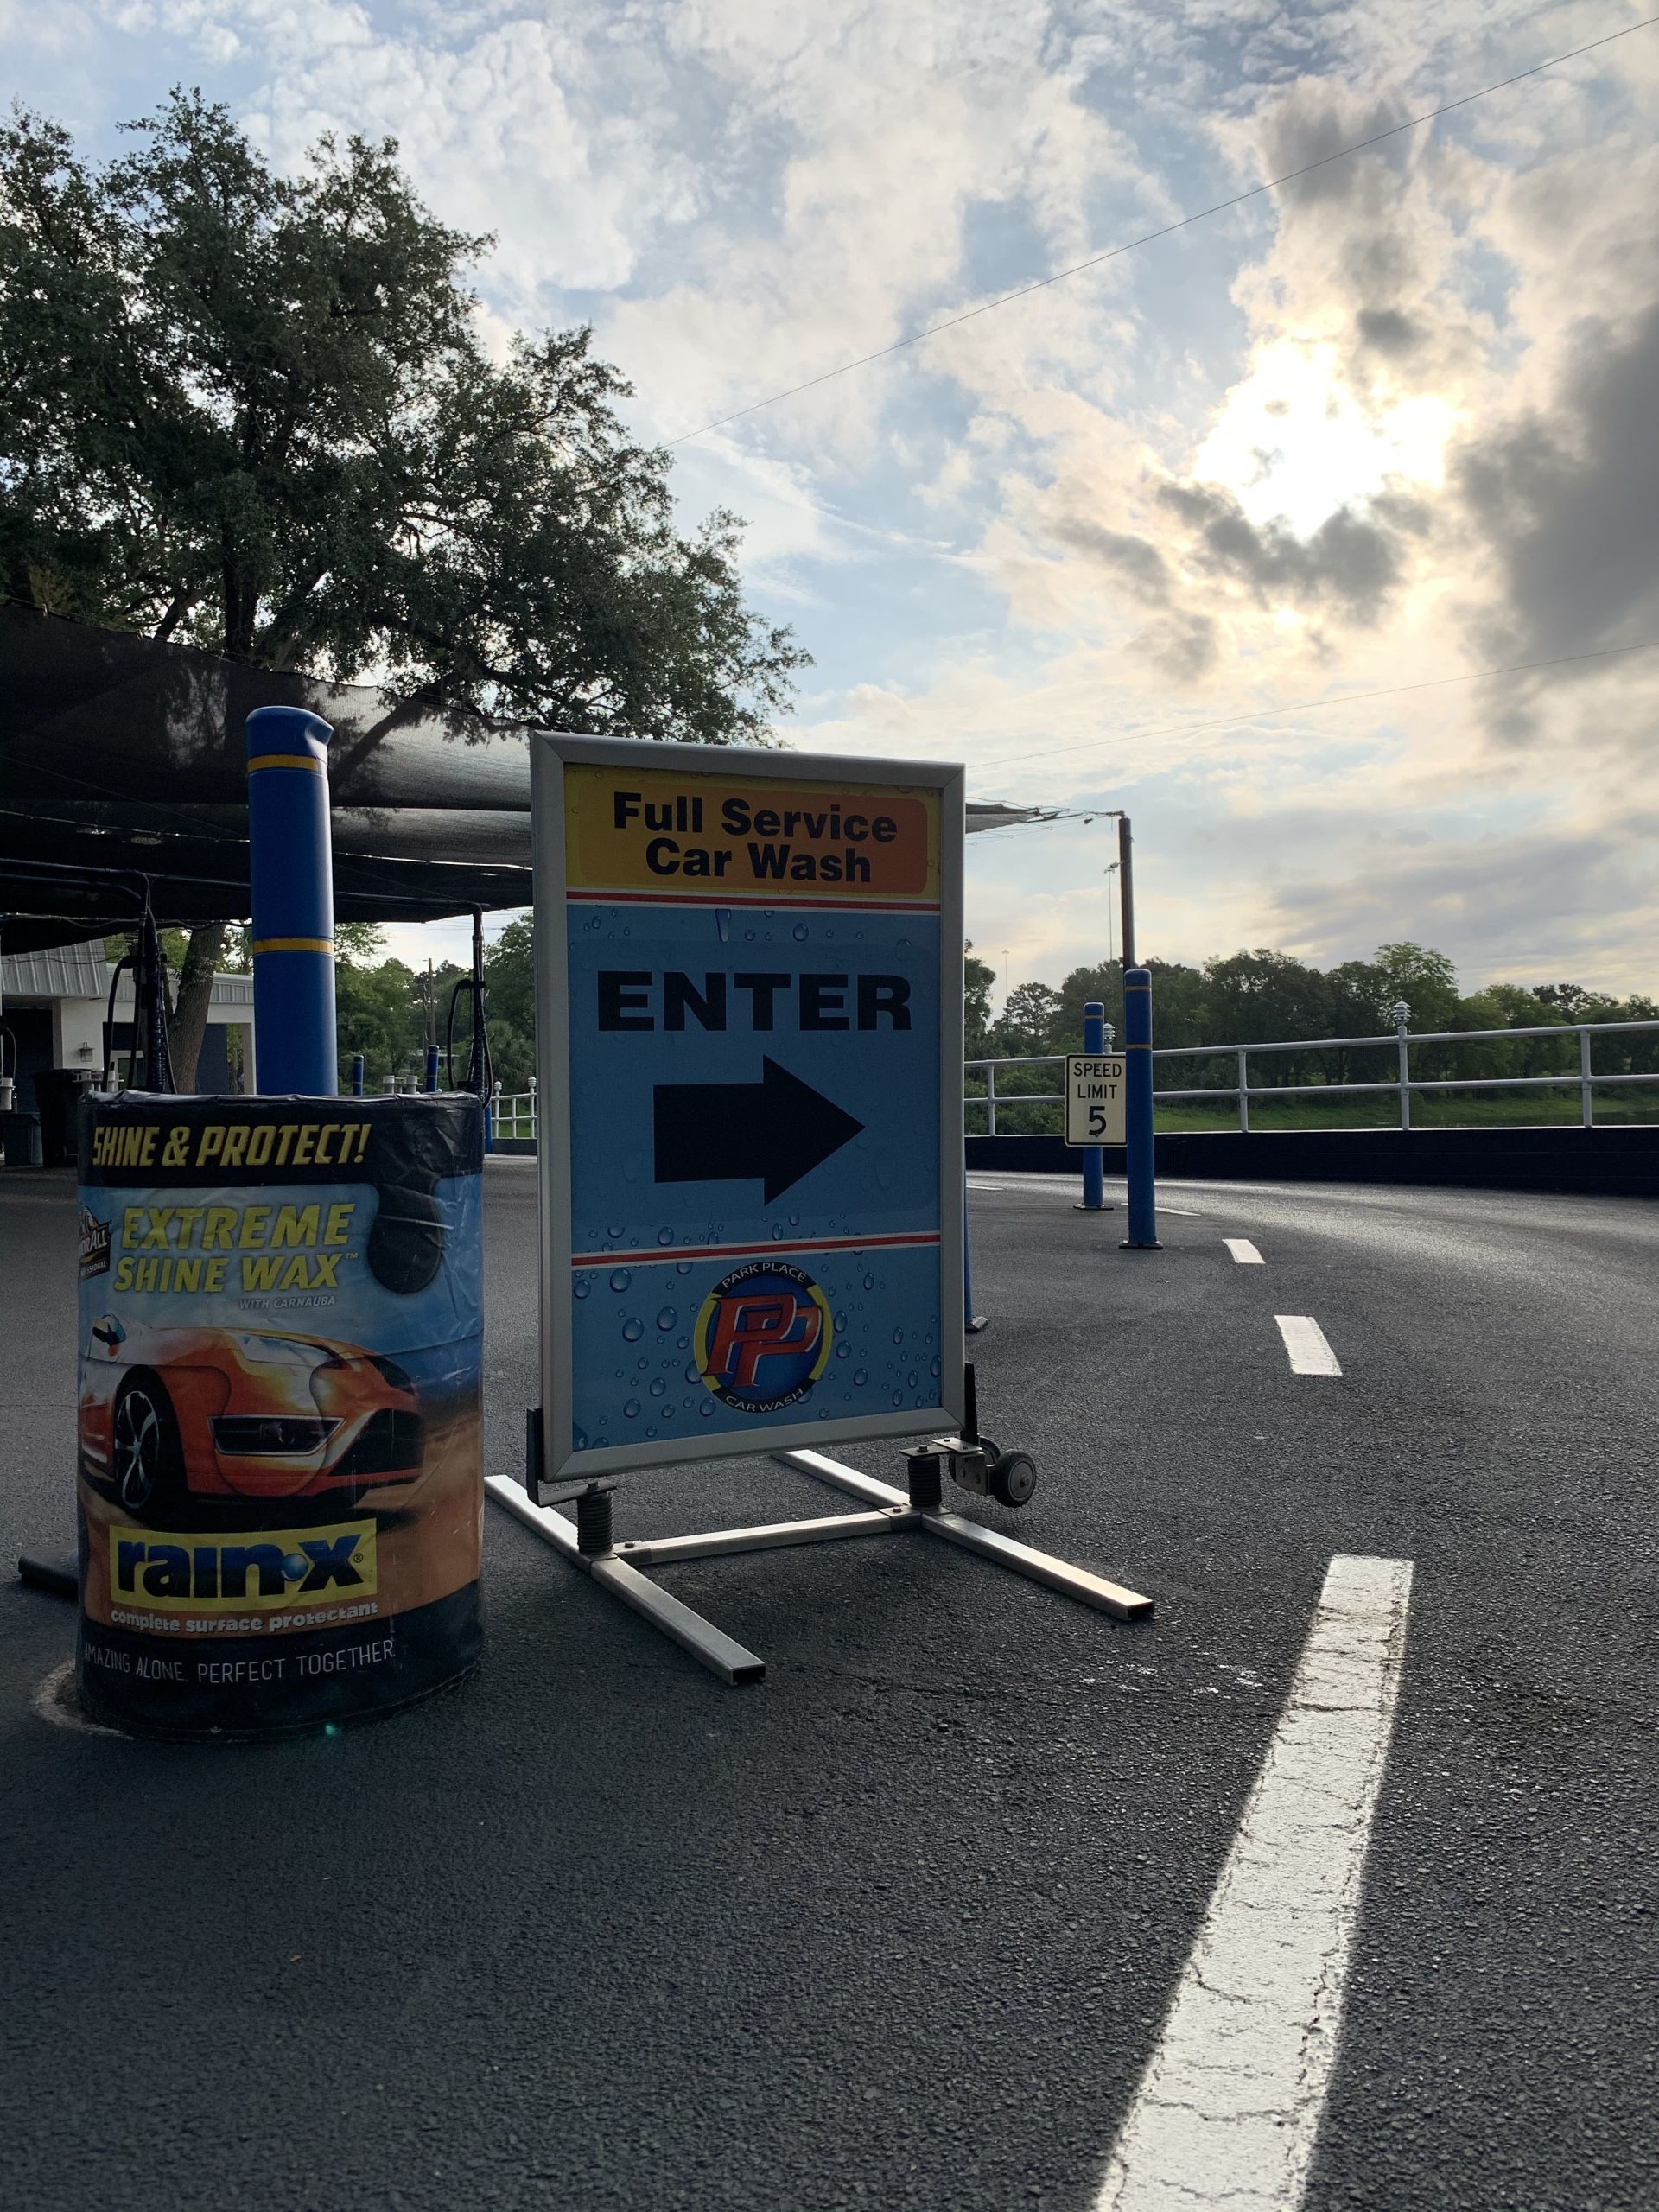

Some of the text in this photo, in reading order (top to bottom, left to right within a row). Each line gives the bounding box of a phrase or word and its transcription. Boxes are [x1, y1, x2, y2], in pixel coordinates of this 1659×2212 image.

[613, 791, 897, 843] Full Service
[645, 837, 872, 883] Car Wash
[597, 970, 913, 1032] ENTER
[1073, 1062, 1122, 1078] SPEED
[1077, 1084, 1117, 1100] LIMIT
[1088, 1106, 1107, 1135] 5
[92, 1124, 372, 1167] SHINE & PROTECT!
[121, 1203, 356, 1250] EXTREME
[113, 1256, 230, 1293] SHINE
[721, 1262, 807, 1288] PARK PLACE
[239, 1296, 337, 1310] WITH CARNAUBA
[725, 1388, 804, 1412] CAR WASH
[111, 1603, 379, 1633] complete surface protectant
[197, 1658, 286, 1683] PERFECT
